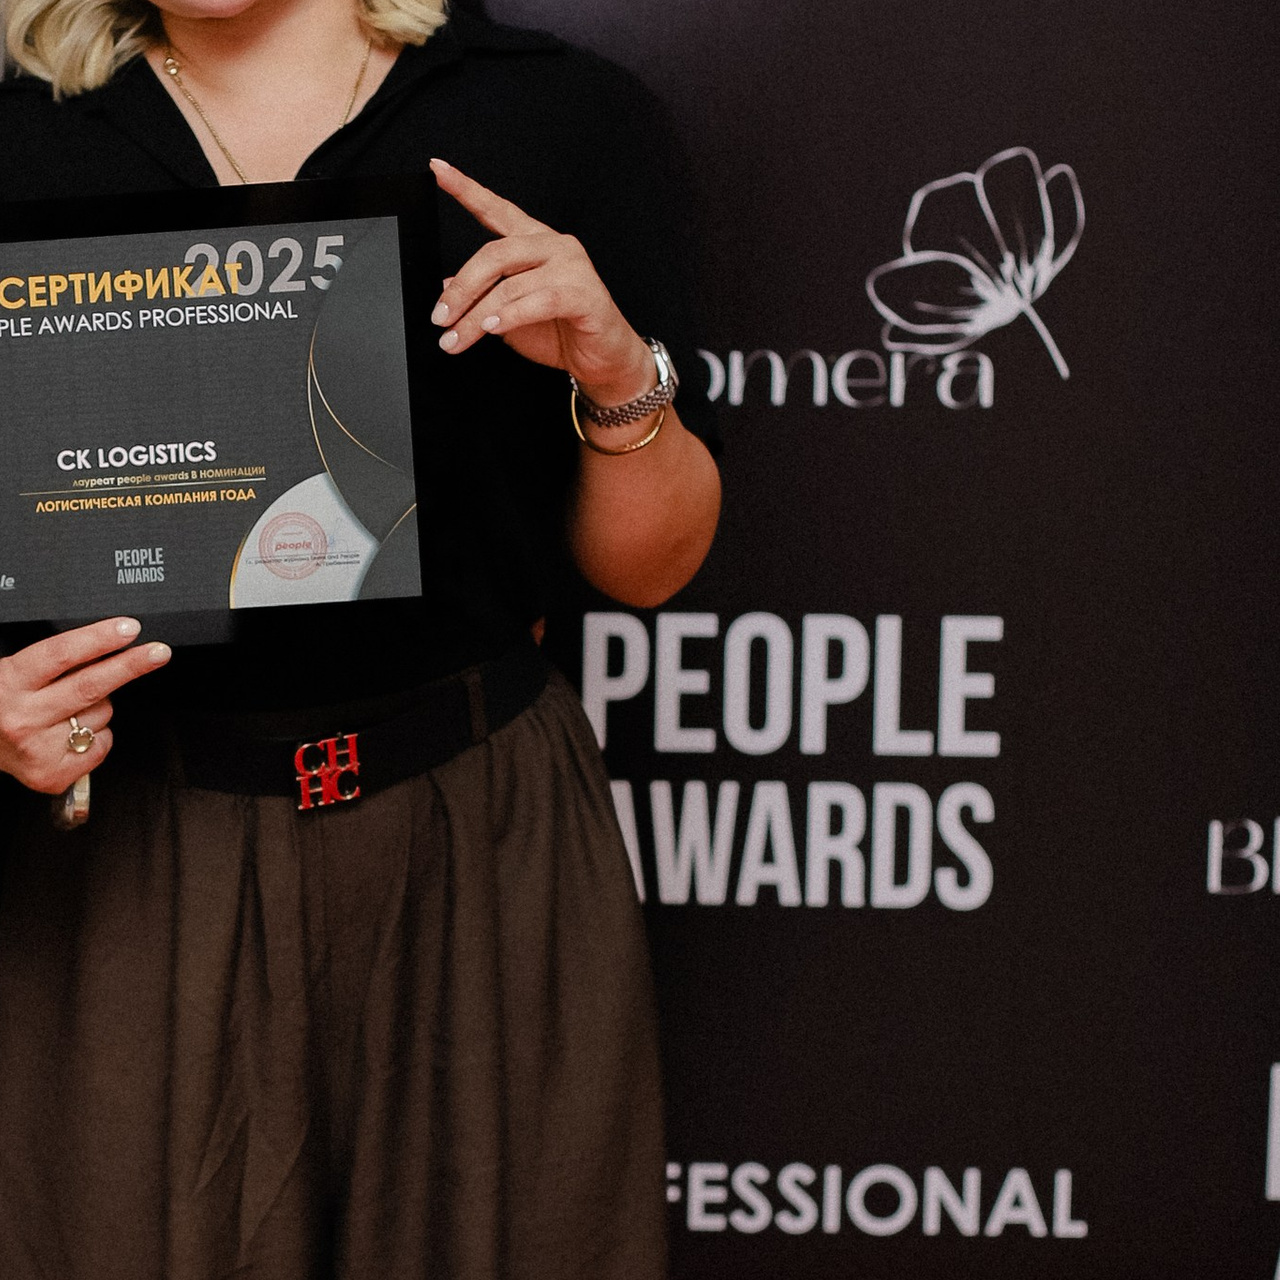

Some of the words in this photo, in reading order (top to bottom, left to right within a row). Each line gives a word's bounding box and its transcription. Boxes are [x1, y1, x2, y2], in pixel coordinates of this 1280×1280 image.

[183, 234, 345, 300] 2025
[37, 310, 134, 337] AWARDS
[139, 300, 299, 329] PROFESSIONAL
[97, 440, 218, 469] LOGISTICS
[73, 476, 116, 489] лауреат
[117, 473, 152, 487] people
[154, 471, 190, 482] awards
[200, 465, 266, 479] НОМИНАЦИИ
[36, 495, 142, 513] ЛОГИСТИЧЕСКАЯ
[145, 490, 218, 507] КОМПАНИЯ
[221, 488, 256, 503] ГОДА
[114, 547, 164, 567] PEOPLE
[117, 566, 165, 585] AWARDS
[582, 611, 1004, 758] PEOPLE
